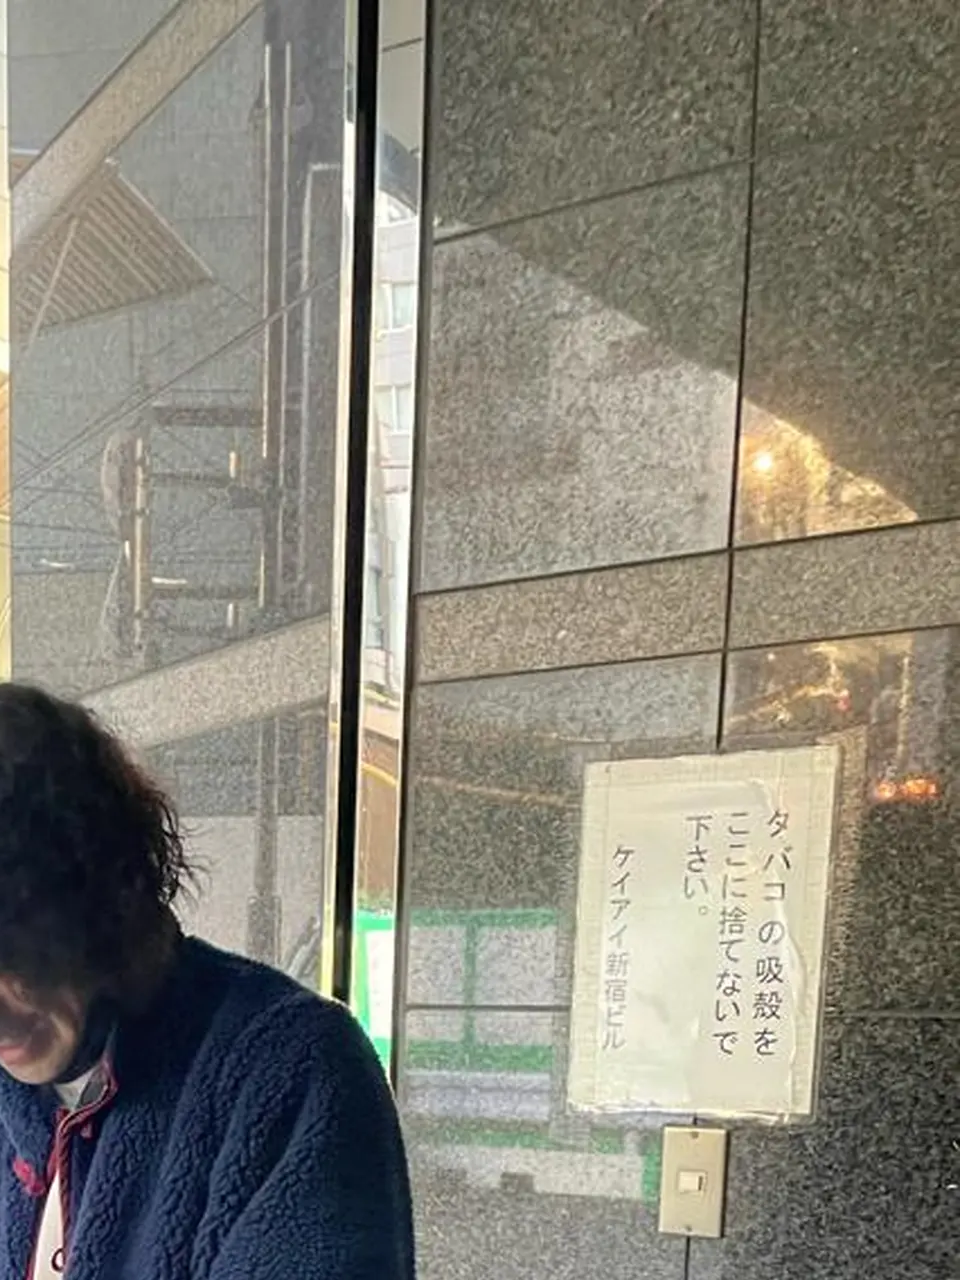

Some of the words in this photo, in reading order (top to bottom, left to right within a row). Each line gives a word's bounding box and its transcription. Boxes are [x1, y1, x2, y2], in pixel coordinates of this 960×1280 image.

[602, 845, 634, 1051] ケイアイ新宿ビル
[683, 814, 713, 917] 下さい。
[712, 812, 750, 1056] ここに捨てないで
[752, 811, 793, 1056] タバコの吸殻を
